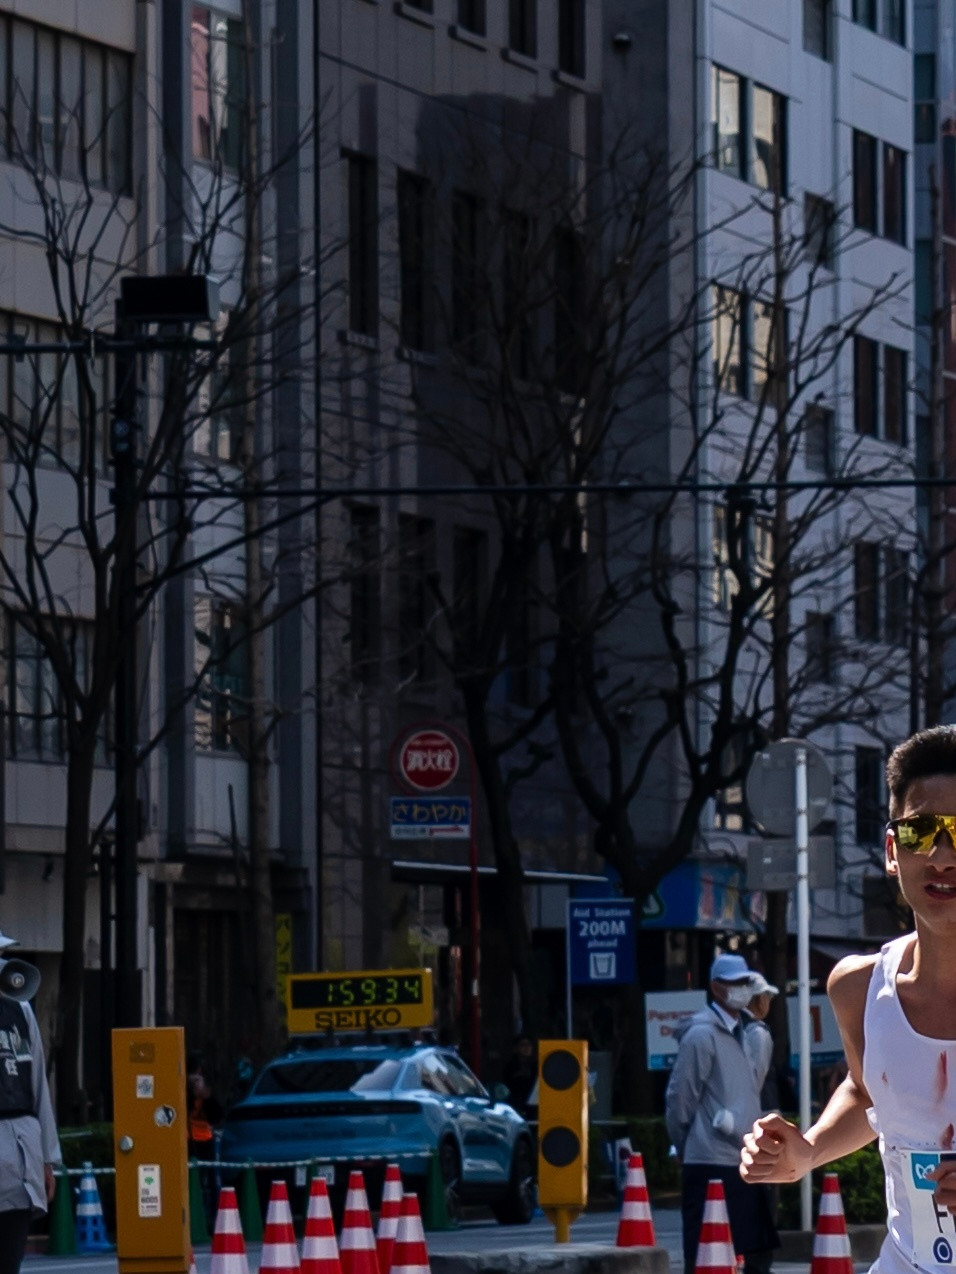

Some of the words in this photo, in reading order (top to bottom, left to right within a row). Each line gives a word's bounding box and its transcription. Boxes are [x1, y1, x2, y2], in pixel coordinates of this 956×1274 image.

[394, 804, 466, 823] さわやか
[579, 920, 626, 937] 200M
[314, 1008, 402, 1029] SEIKO
